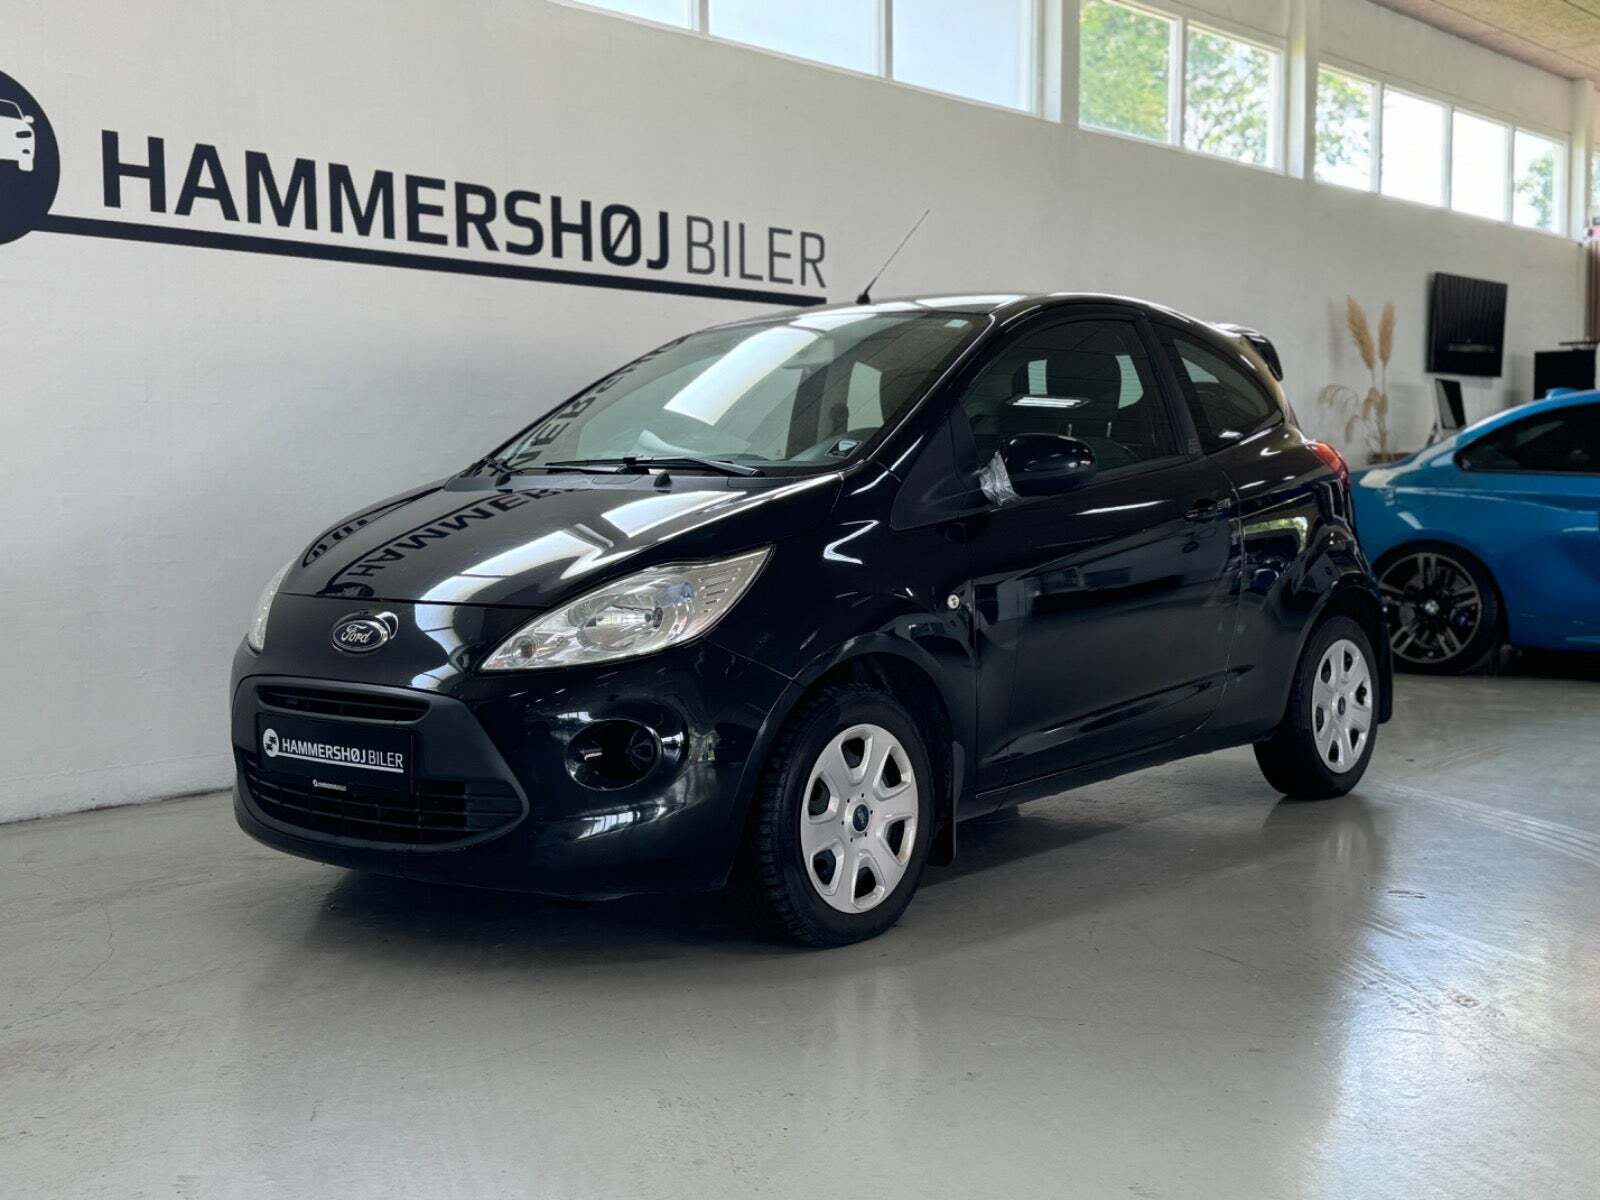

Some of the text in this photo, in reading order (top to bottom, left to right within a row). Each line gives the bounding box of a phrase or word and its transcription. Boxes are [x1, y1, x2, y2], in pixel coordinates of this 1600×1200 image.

[101, 129, 826, 289] HAMMERSHØJ BILER
[341, 623, 374, 644] Ford
[281, 737, 404, 769] HAMMERSHØJ BILER
